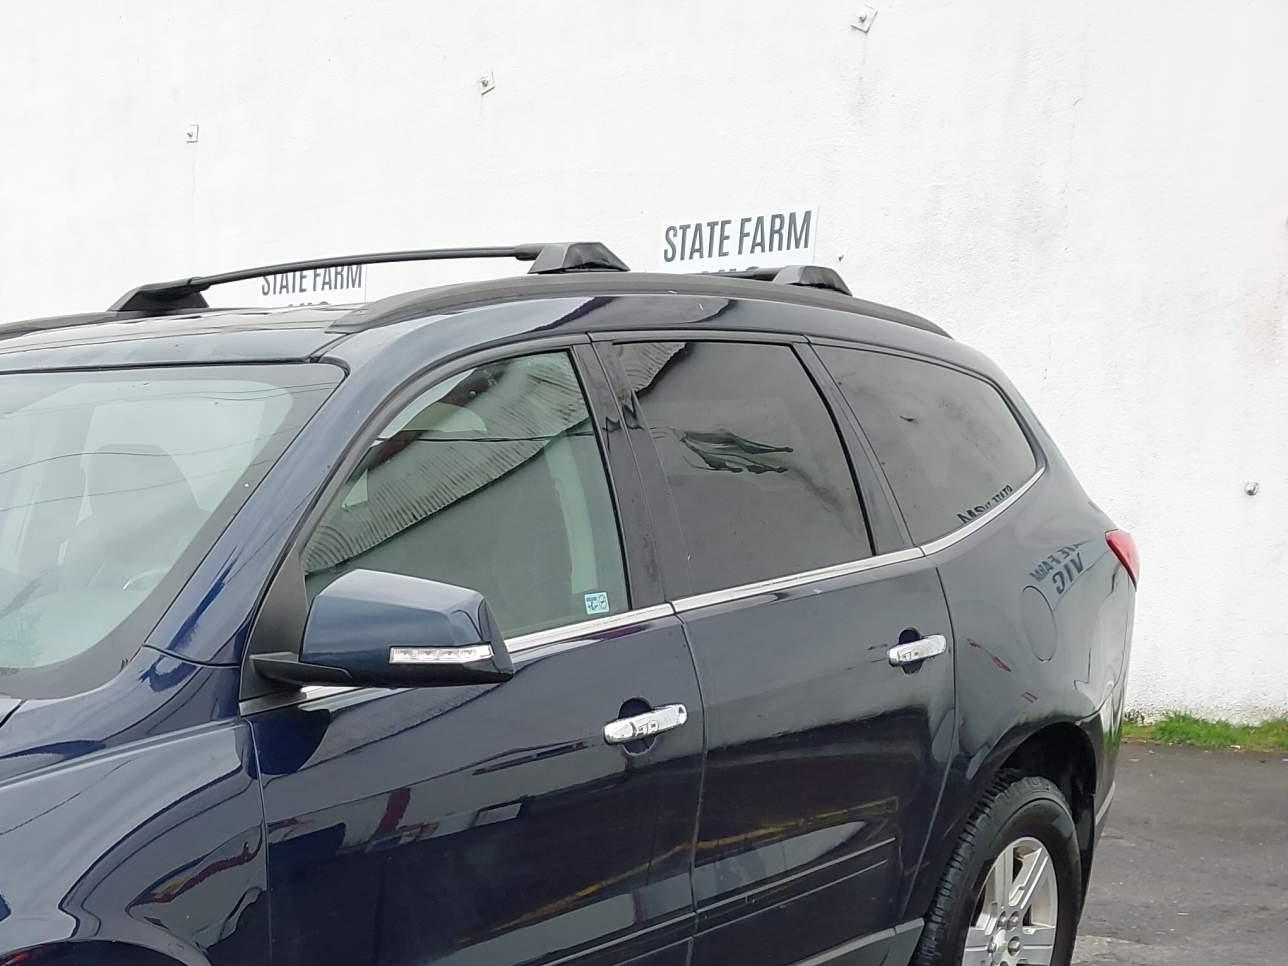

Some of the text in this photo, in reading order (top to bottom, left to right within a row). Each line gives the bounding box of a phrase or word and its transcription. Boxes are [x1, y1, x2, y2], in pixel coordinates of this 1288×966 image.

[663, 210, 812, 263] STATE FARM
[261, 263, 363, 296] STATE FARM
